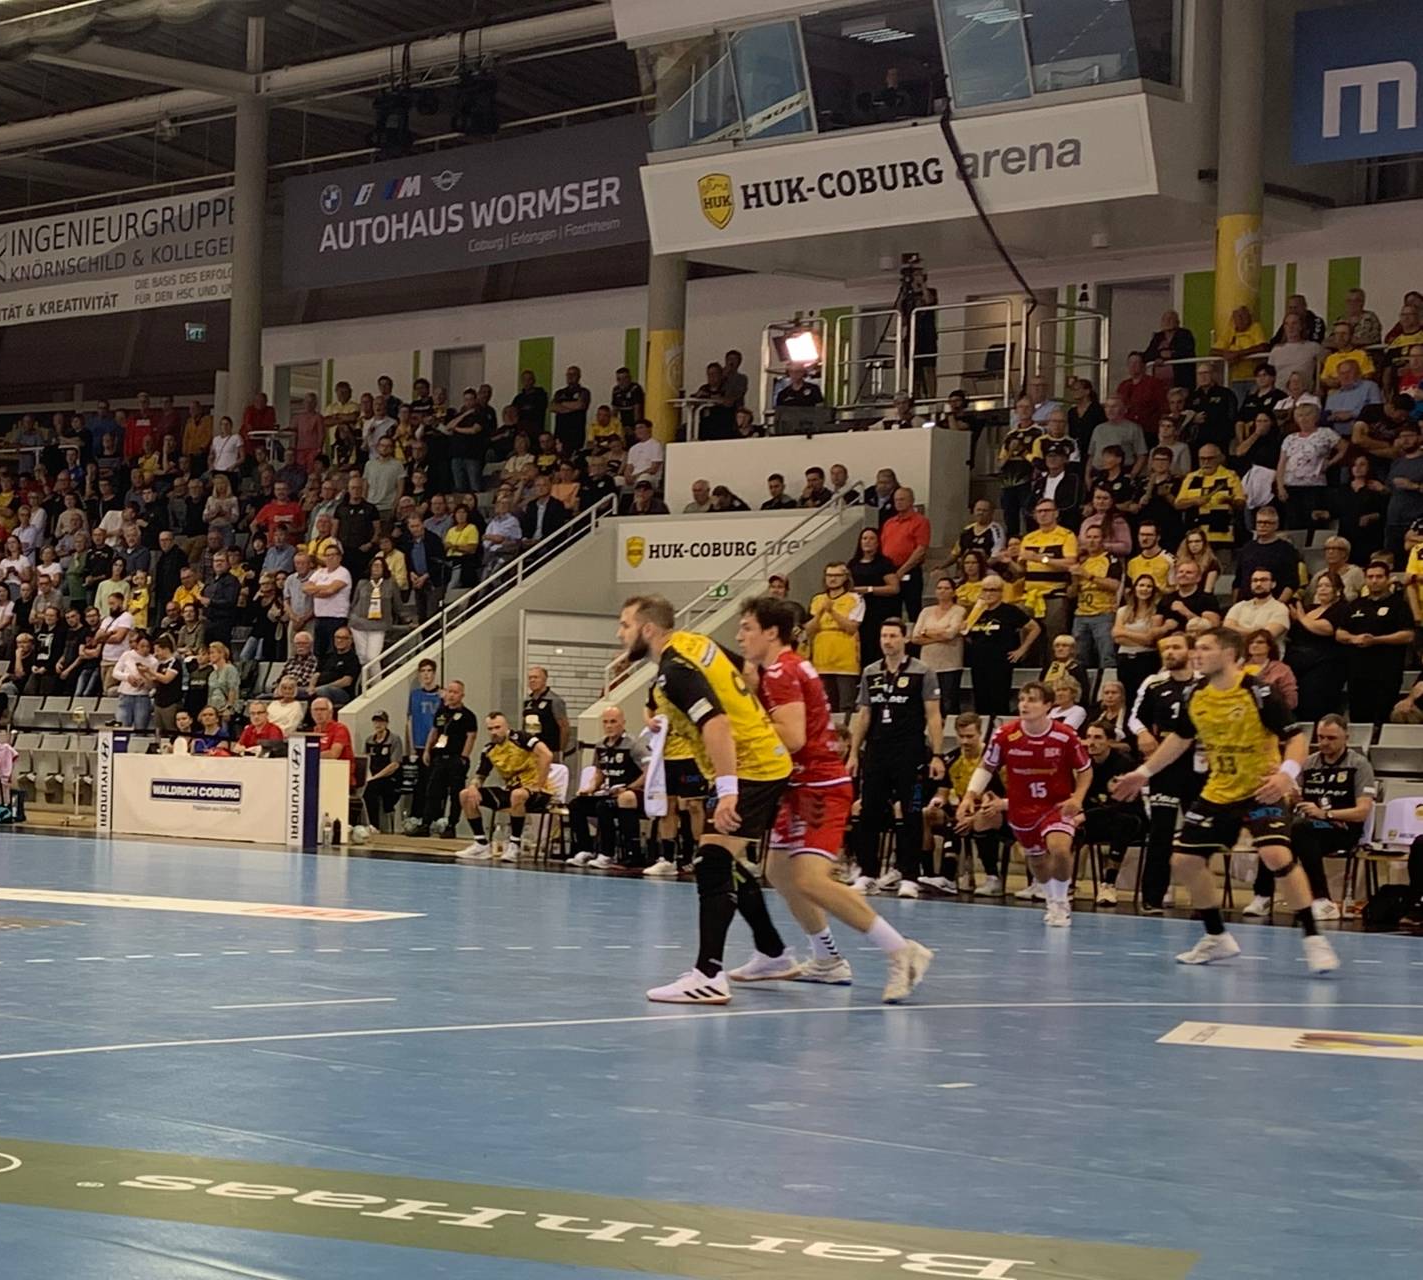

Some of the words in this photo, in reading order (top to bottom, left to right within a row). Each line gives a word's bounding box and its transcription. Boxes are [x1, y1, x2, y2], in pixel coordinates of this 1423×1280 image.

[741, 157, 944, 210] HUK-COBURG
[956, 137, 1082, 181] arena
[319, 203, 465, 252] AUTOHAUS
[470, 175, 621, 229] WORMSER
[467, 237, 504, 253] Coburg
[10, 250, 126, 283] KNÖRNSCHILD
[132, 249, 145, 267] &
[134, 278, 150, 290] DIE
[152, 273, 177, 289] BASIS
[179, 271, 198, 285] DES
[197, 284, 218, 297] UND
[25, 302, 35, 318] &
[39, 291, 120, 316] KREATIVITÄT
[648, 540, 758, 559] HUK-COBURG
[100, 765, 110, 828] HYUNDAI
[151, 783, 198, 797] WALDRICH
[198, 785, 241, 800] COBURG
[1028, 781, 1048, 799] 15
[290, 773, 300, 840] HYUNDAI
